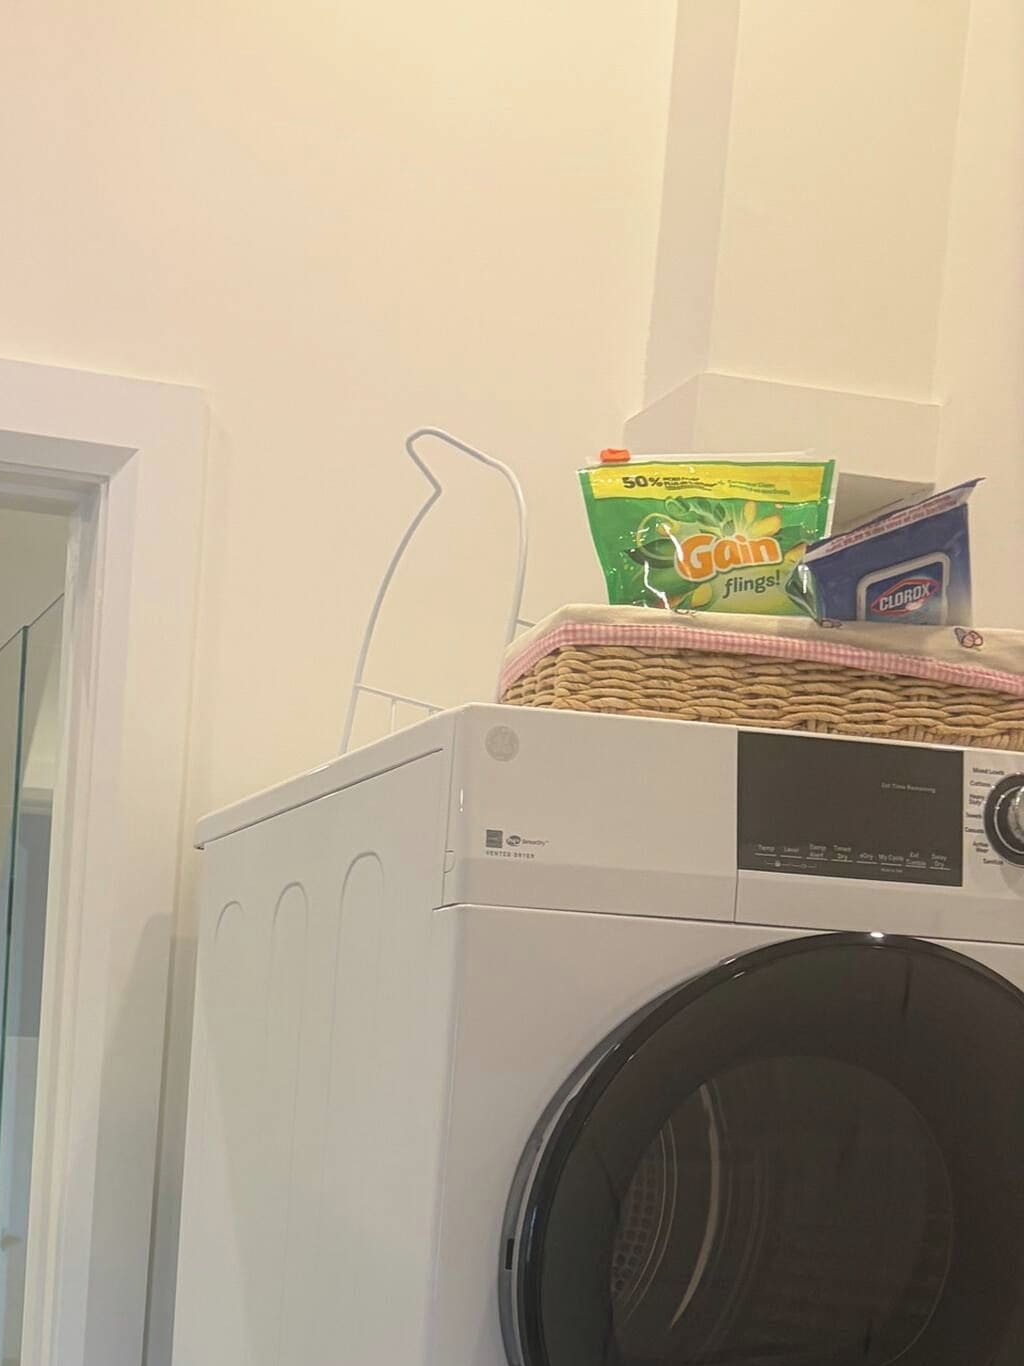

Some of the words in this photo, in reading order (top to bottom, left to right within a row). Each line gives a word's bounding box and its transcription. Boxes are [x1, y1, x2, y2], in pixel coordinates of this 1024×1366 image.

[622, 475, 663, 489] 50%
[676, 533, 781, 580] Gain
[722, 569, 780, 599] flings!
[879, 583, 931, 611] CLOROX
